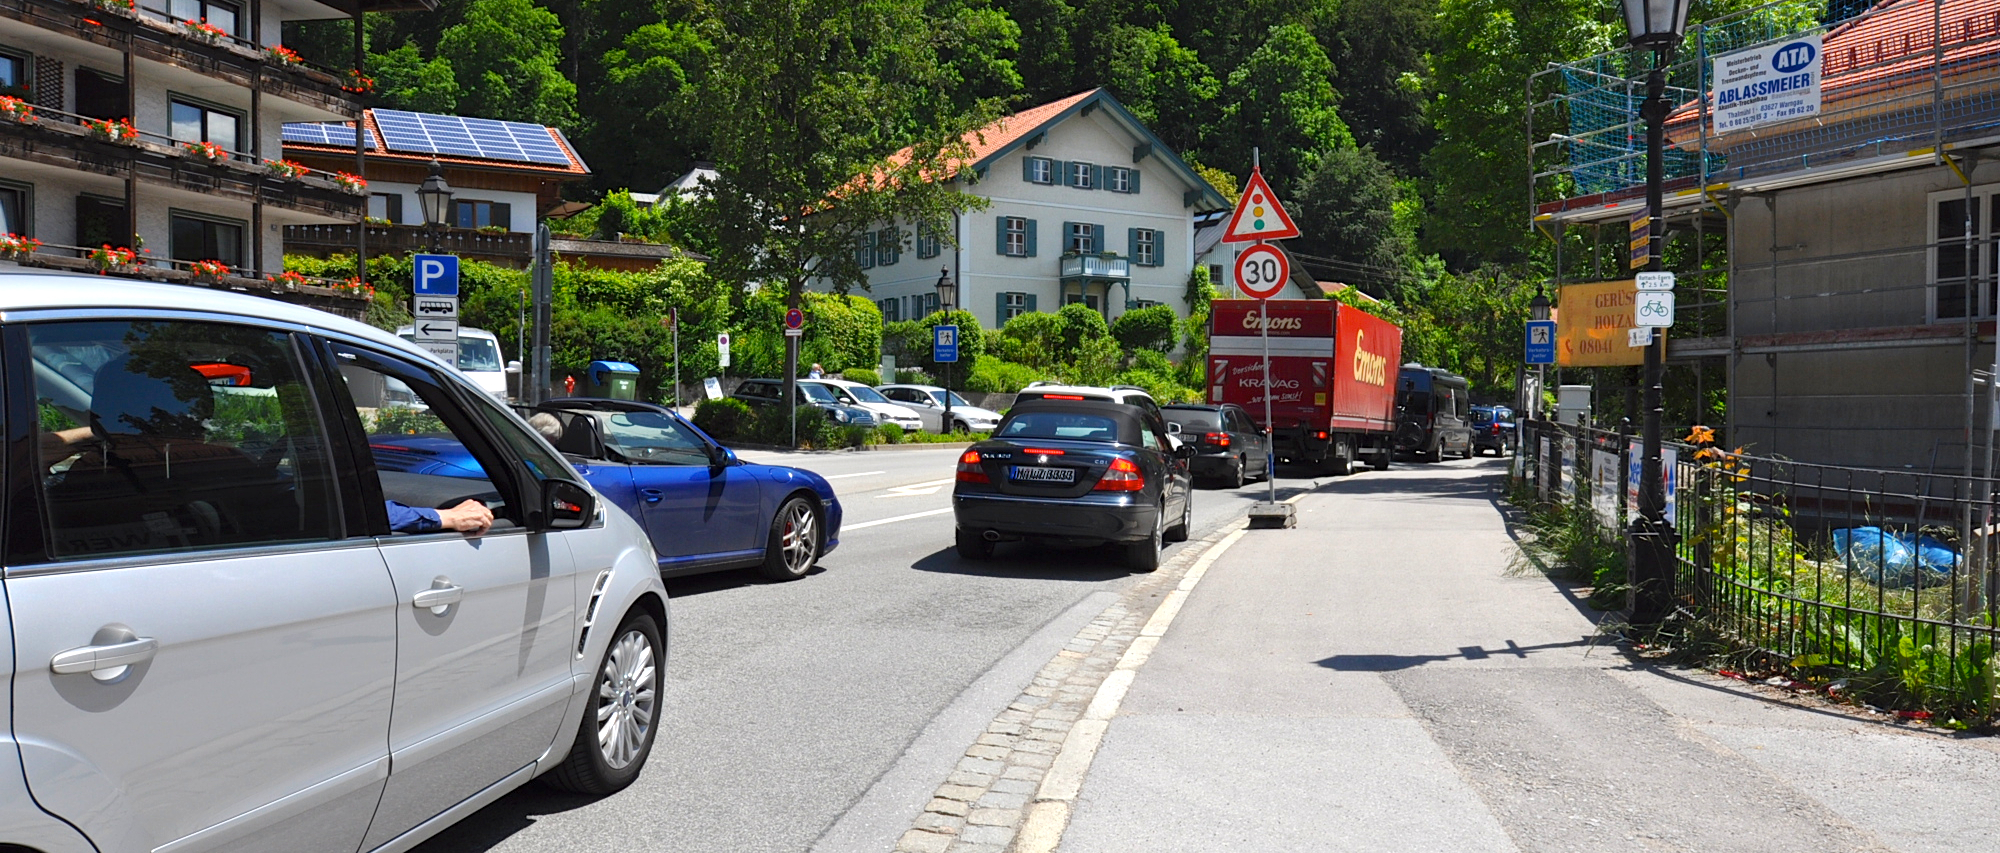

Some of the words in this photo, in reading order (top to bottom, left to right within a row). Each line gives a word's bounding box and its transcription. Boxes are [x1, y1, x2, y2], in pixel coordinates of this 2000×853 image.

[1726, 54, 1762, 67] Meisterbetrieb
[1777, 46, 1810, 69] ATA
[1718, 72, 1810, 105] ABLASSMEIER
[1777, 109, 1787, 117] Fax
[1780, 99, 1803, 109] Warngau
[422, 260, 444, 289] P
[1245, 258, 1277, 285] 30
[1242, 310, 1302, 330] Emons
[1579, 338, 1613, 354] 08041
[1353, 329, 1386, 387] Emons
[1239, 378, 1300, 389] KRAVAG
